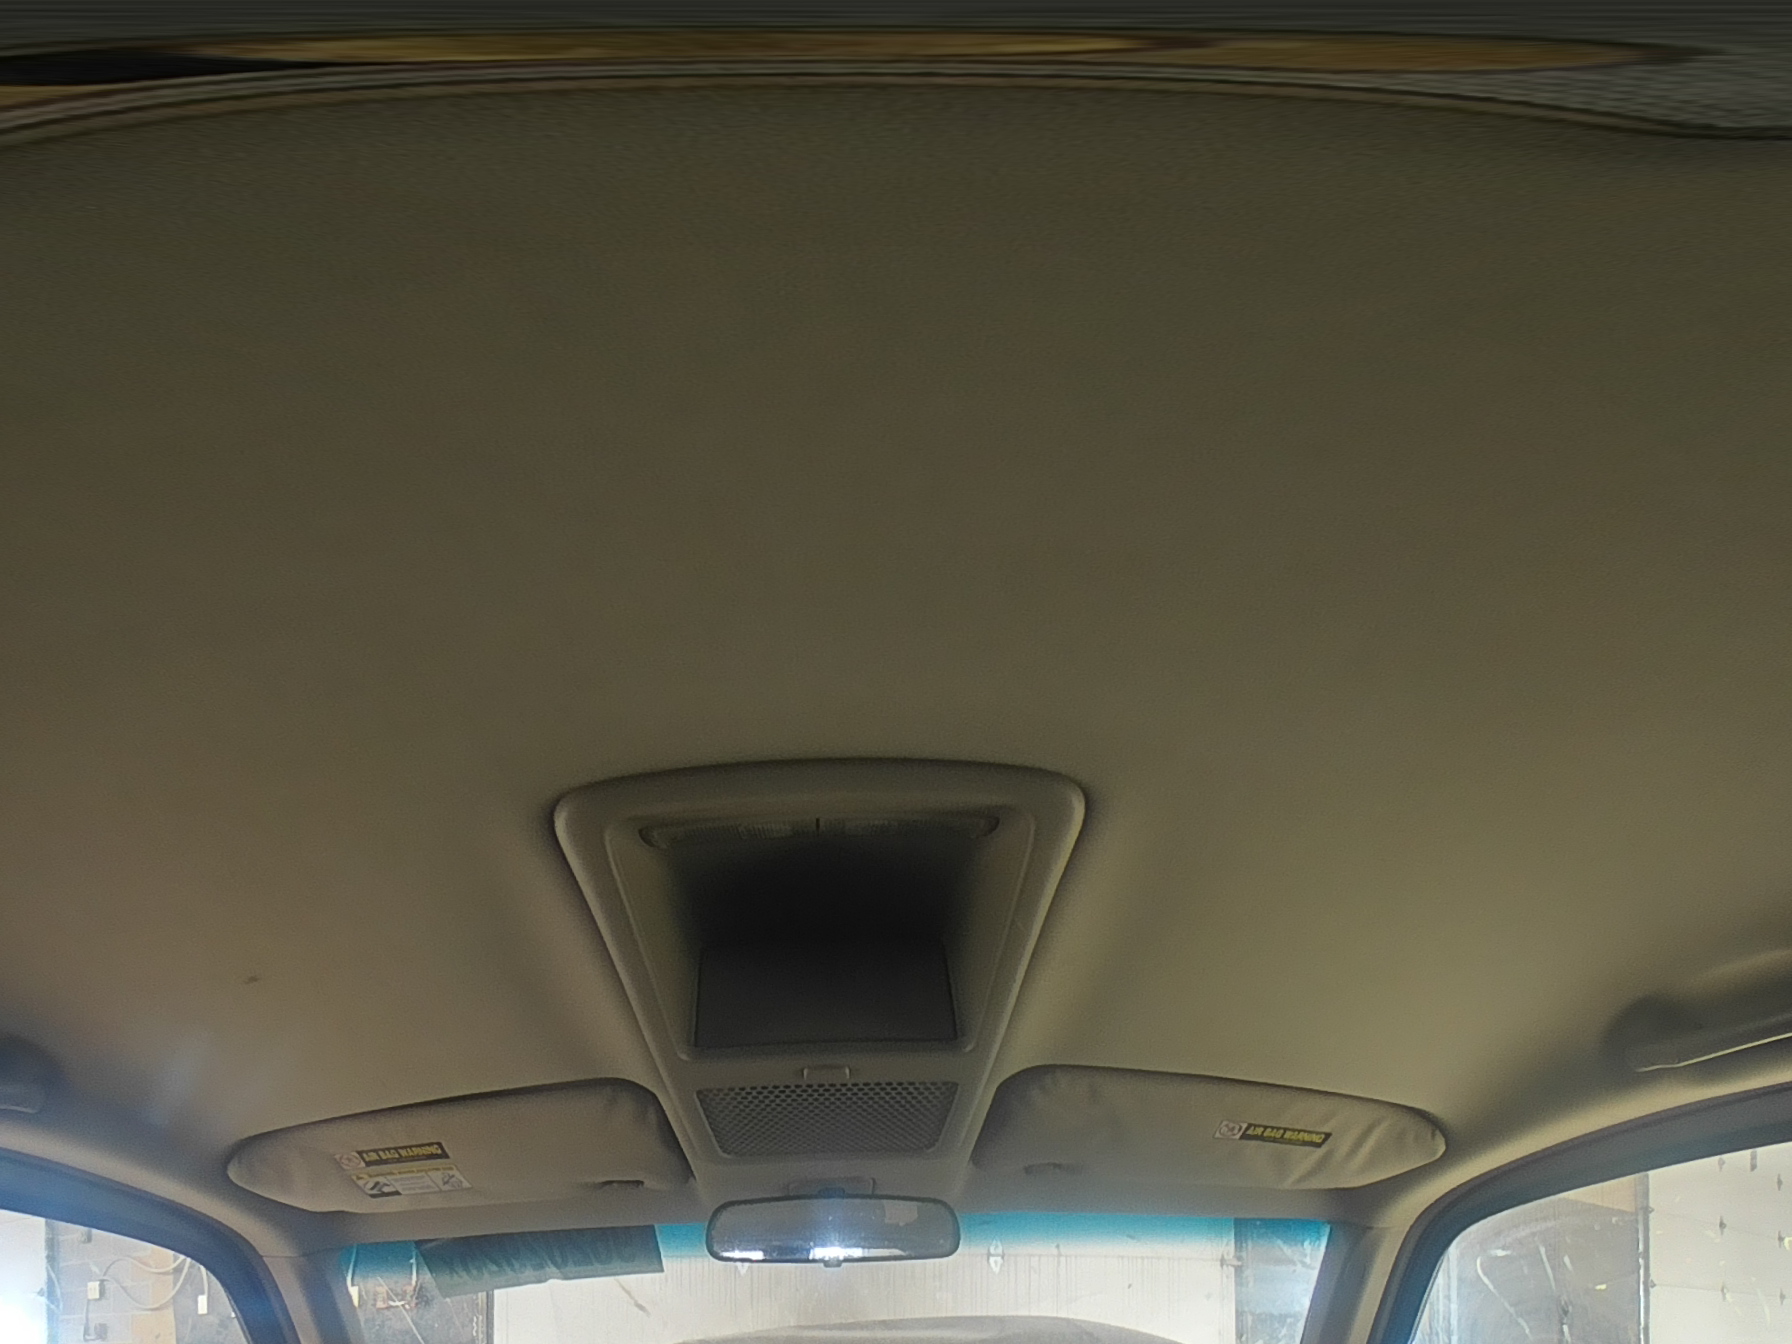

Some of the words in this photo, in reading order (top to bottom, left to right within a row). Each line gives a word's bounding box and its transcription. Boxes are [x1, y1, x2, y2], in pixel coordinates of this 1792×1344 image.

[1246, 1126, 1264, 1135] AIR
[1263, 1128, 1284, 1138] BAG
[1284, 1130, 1325, 1143] WARNING
[362, 1151, 380, 1162] AIR
[378, 1149, 399, 1160] BAG
[398, 1144, 442, 1157] WARNING
